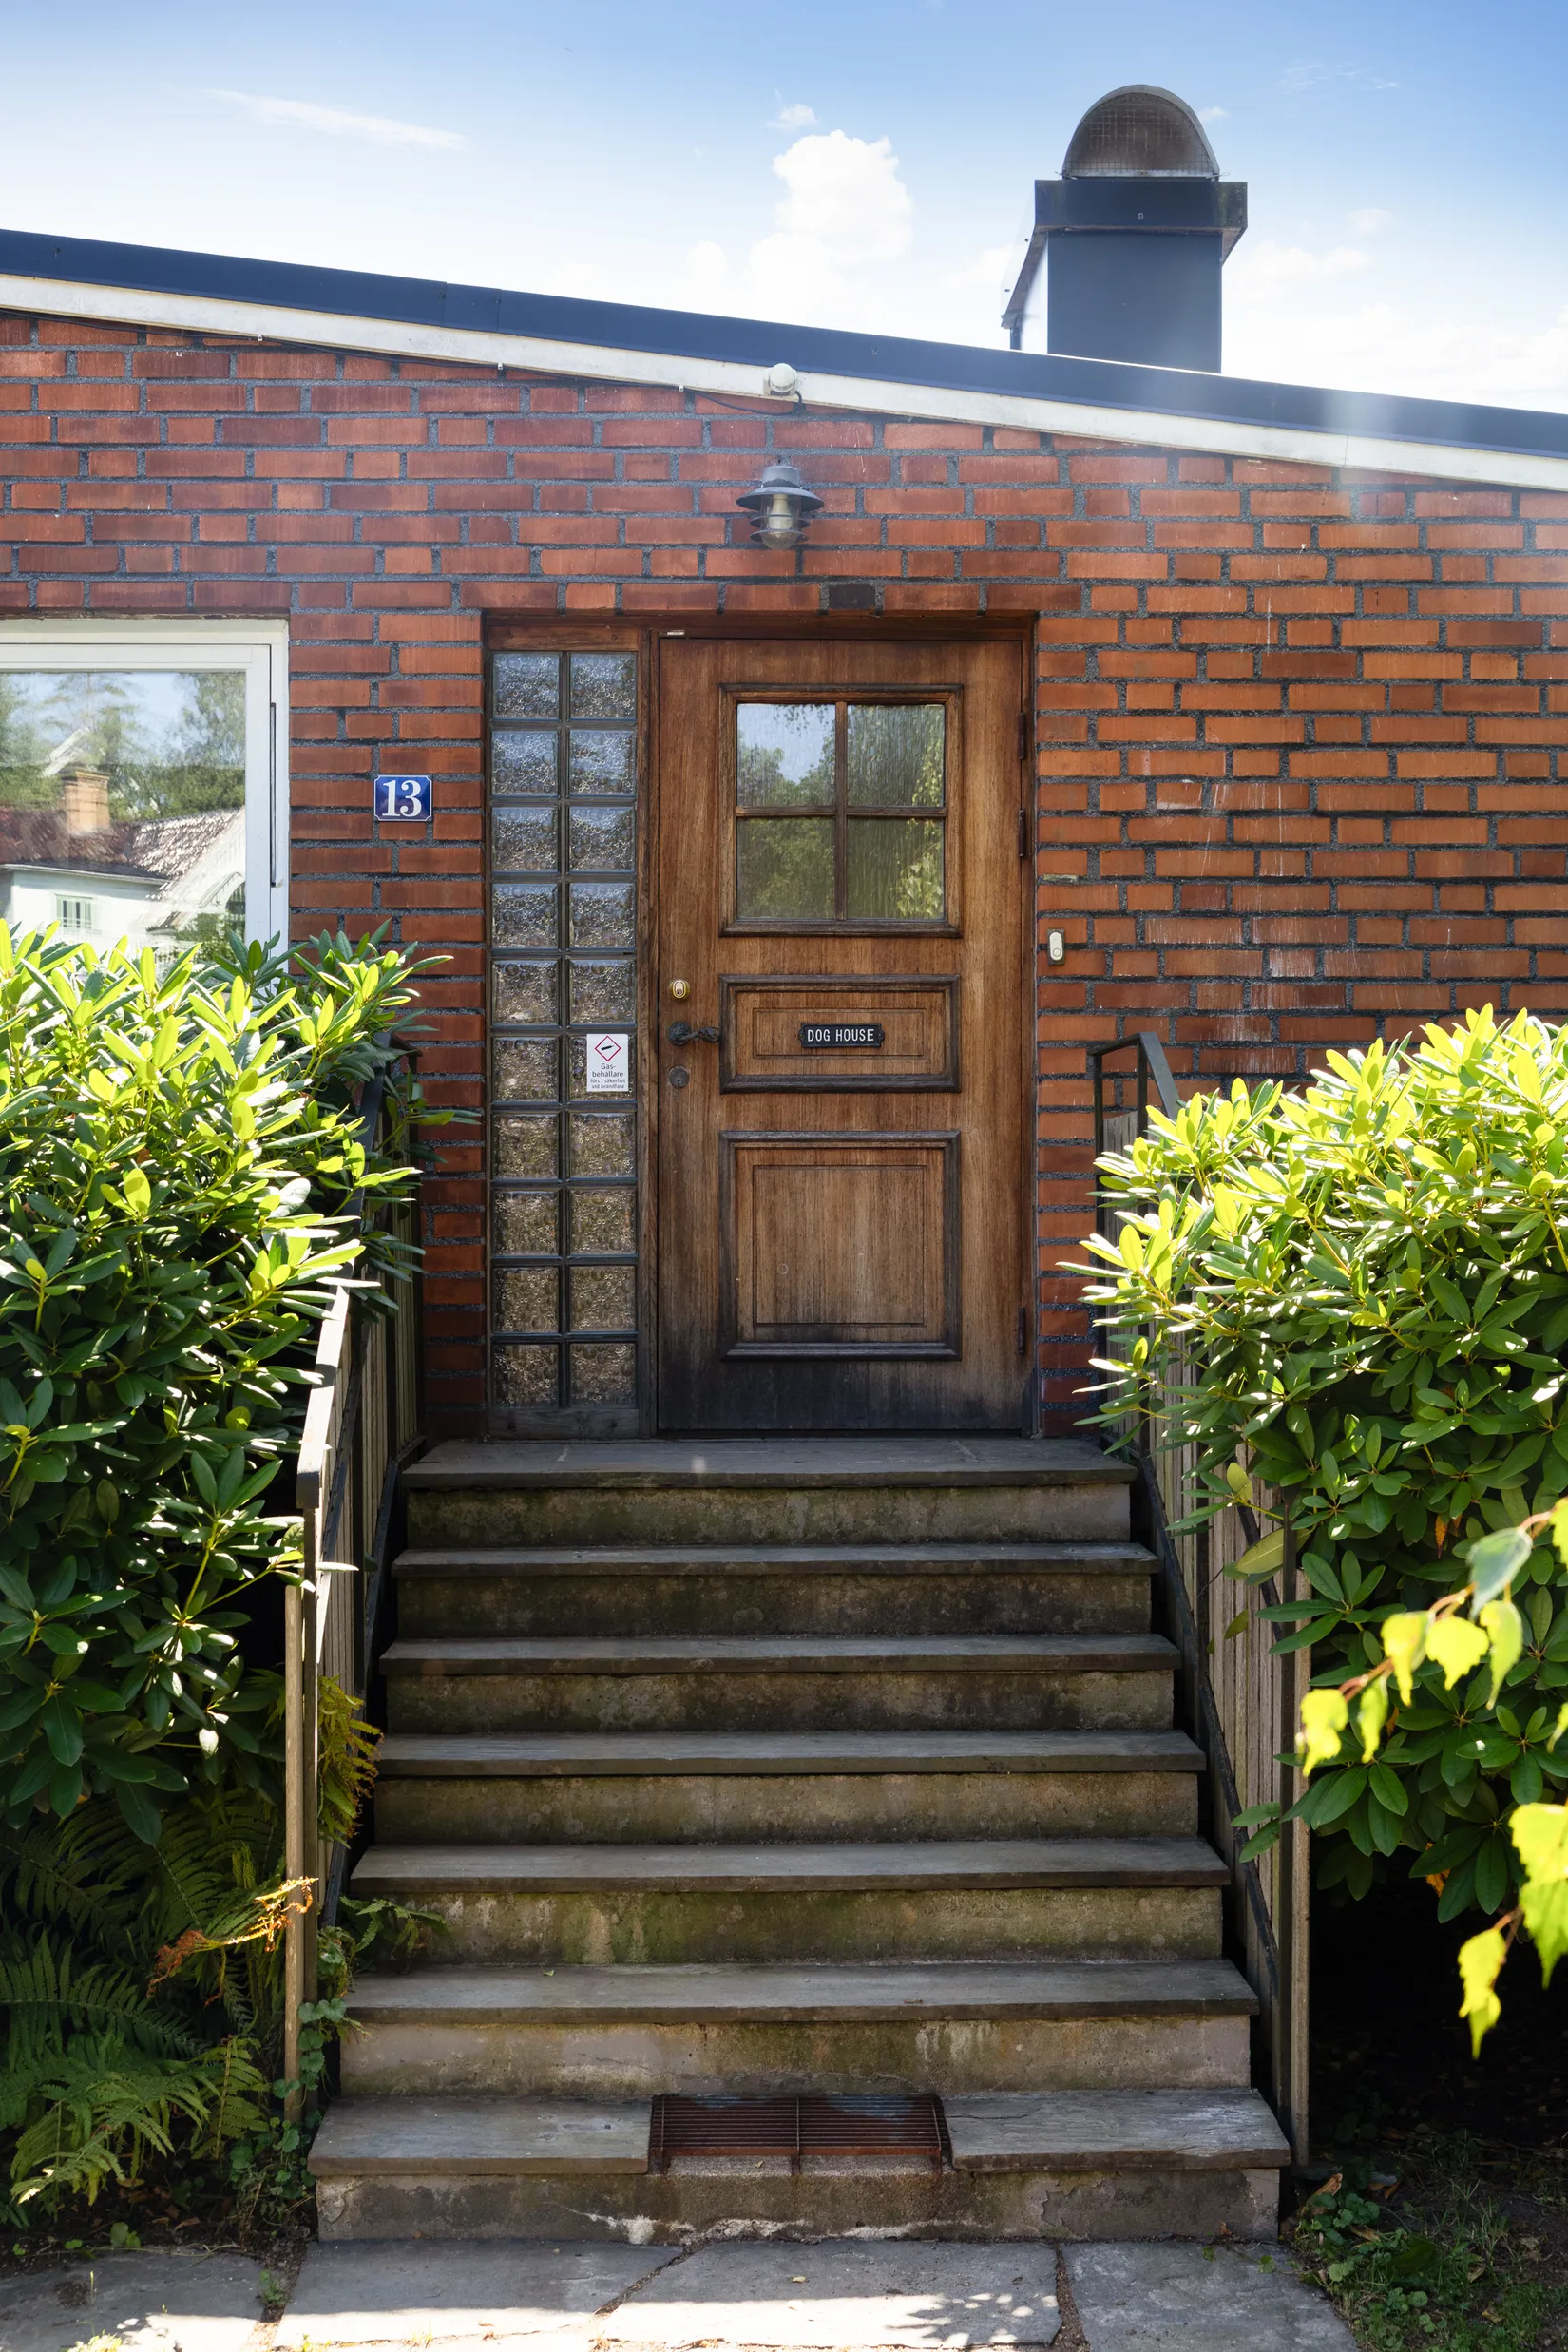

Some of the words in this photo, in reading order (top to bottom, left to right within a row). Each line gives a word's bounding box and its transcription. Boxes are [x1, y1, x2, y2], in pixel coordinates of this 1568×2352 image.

[382, 779, 422, 817] 13
[807, 1029, 831, 1042] DOG
[835, 1028, 875, 1042] HOUSE
